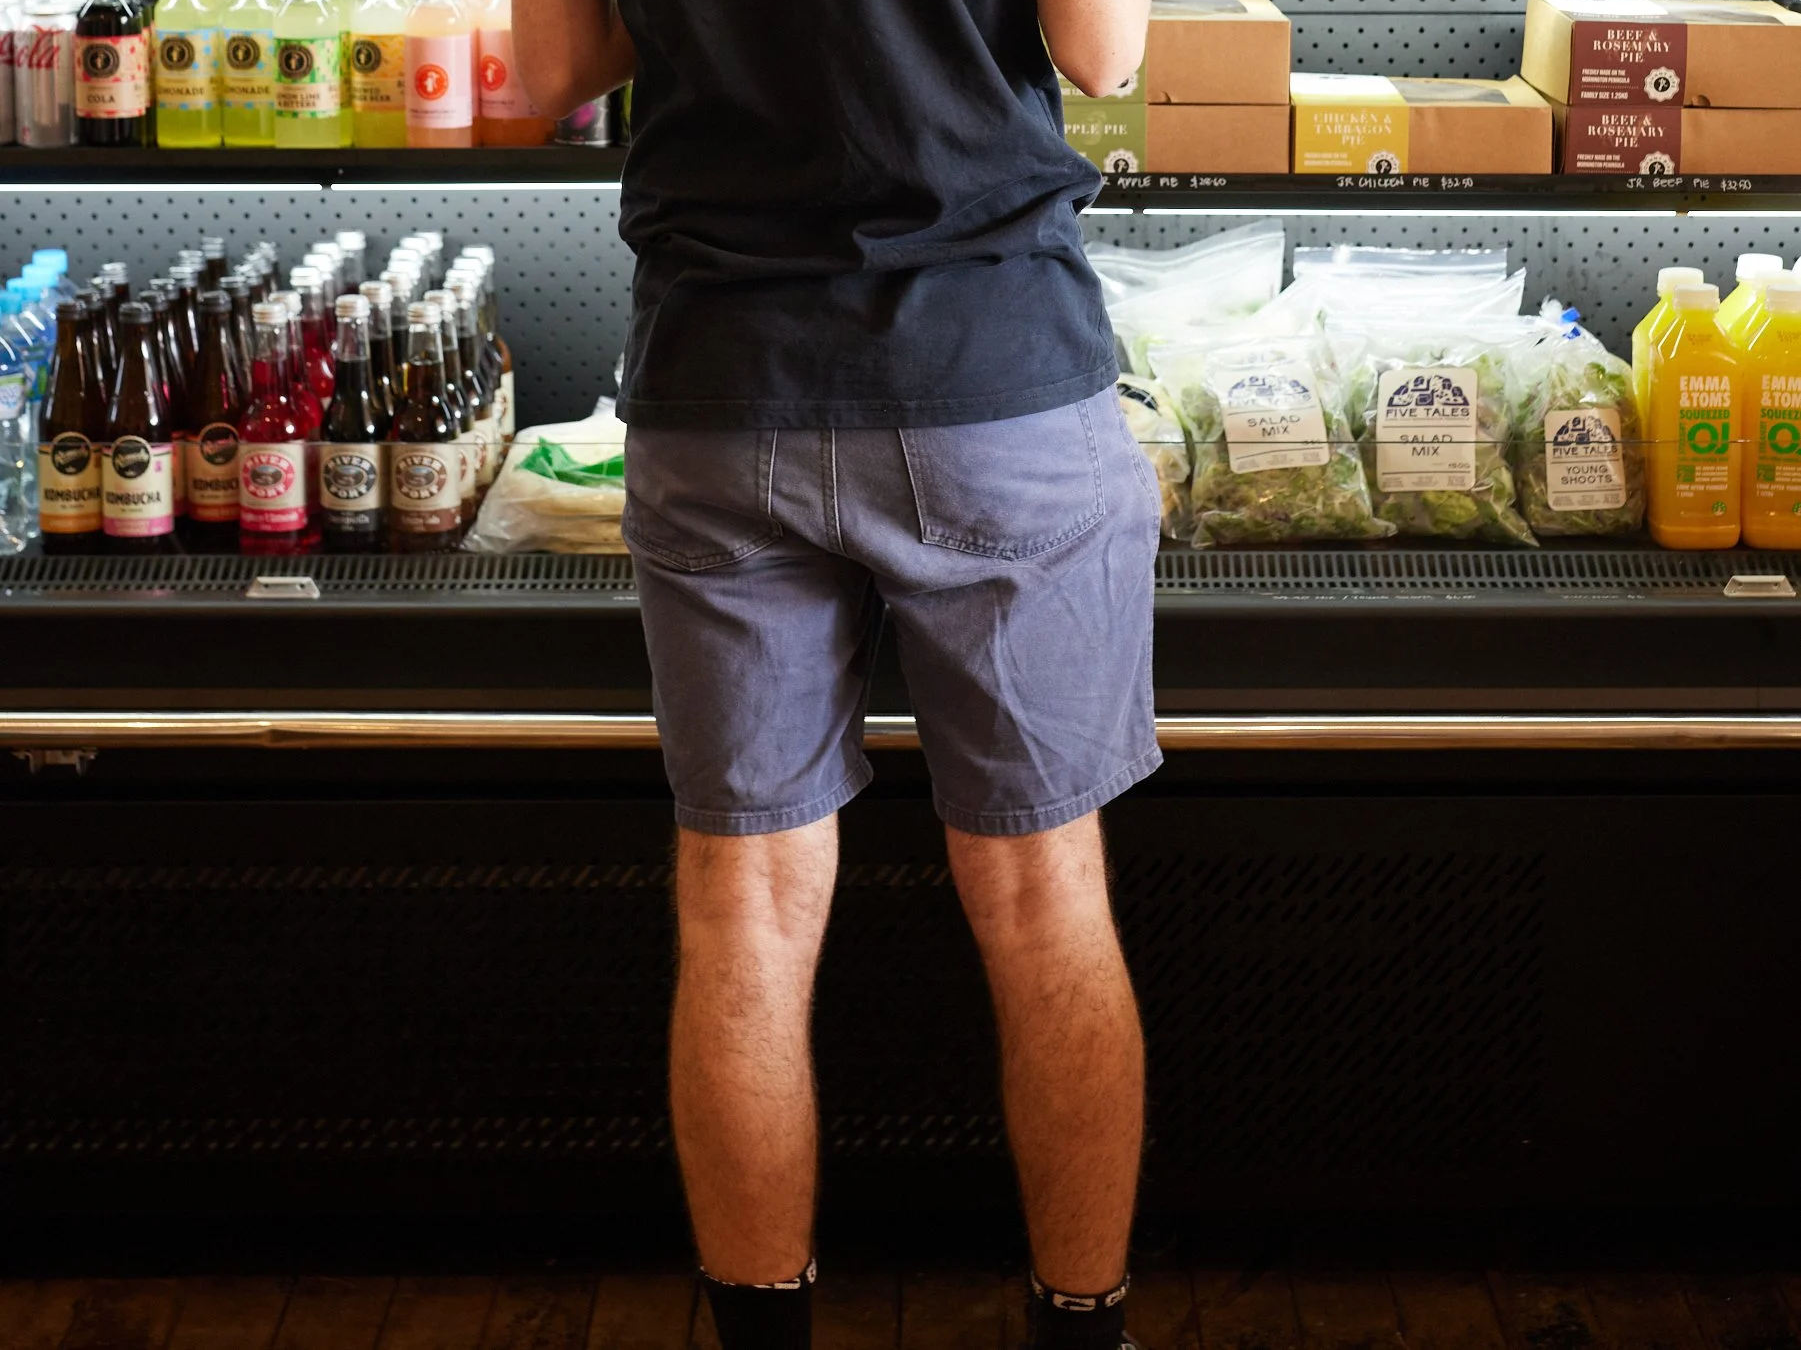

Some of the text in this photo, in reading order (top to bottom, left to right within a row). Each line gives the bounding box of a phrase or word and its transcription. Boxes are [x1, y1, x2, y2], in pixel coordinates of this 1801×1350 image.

[1607, 29, 1657, 41] BEEF &
[1593, 40, 1671, 53] ROSEMARY
[1620, 52, 1644, 63] PIE
[1313, 113, 1379, 124] CHICKEN
[1602, 115, 1651, 126] BEEF &
[1104, 124, 1128, 135] PIE
[1314, 124, 1392, 135] TARRAGON
[1588, 125, 1664, 137] ROSEMARY
[1341, 135, 1365, 146] PIE
[1615, 137, 1638, 147] PIE
[1336, 176, 1430, 187] JR CHICKEN PIE
[1626, 178, 1709, 189] JR BEEF PIE
[1680, 376, 1730, 390] EMMA
[1385, 407, 1470, 418] FIVE TALES
[1680, 410, 1730, 419] SQUEEZED
[1247, 415, 1300, 427] SALAD
[1262, 425, 1290, 437] MIX
[1688, 422, 1730, 454] OJ
[1400, 434, 1453, 457] SALAD MIX
[1552, 445, 1618, 456] FIVE TALES
[1565, 465, 1608, 475] YOUNG
[1561, 474, 1613, 485] SHOOTS
